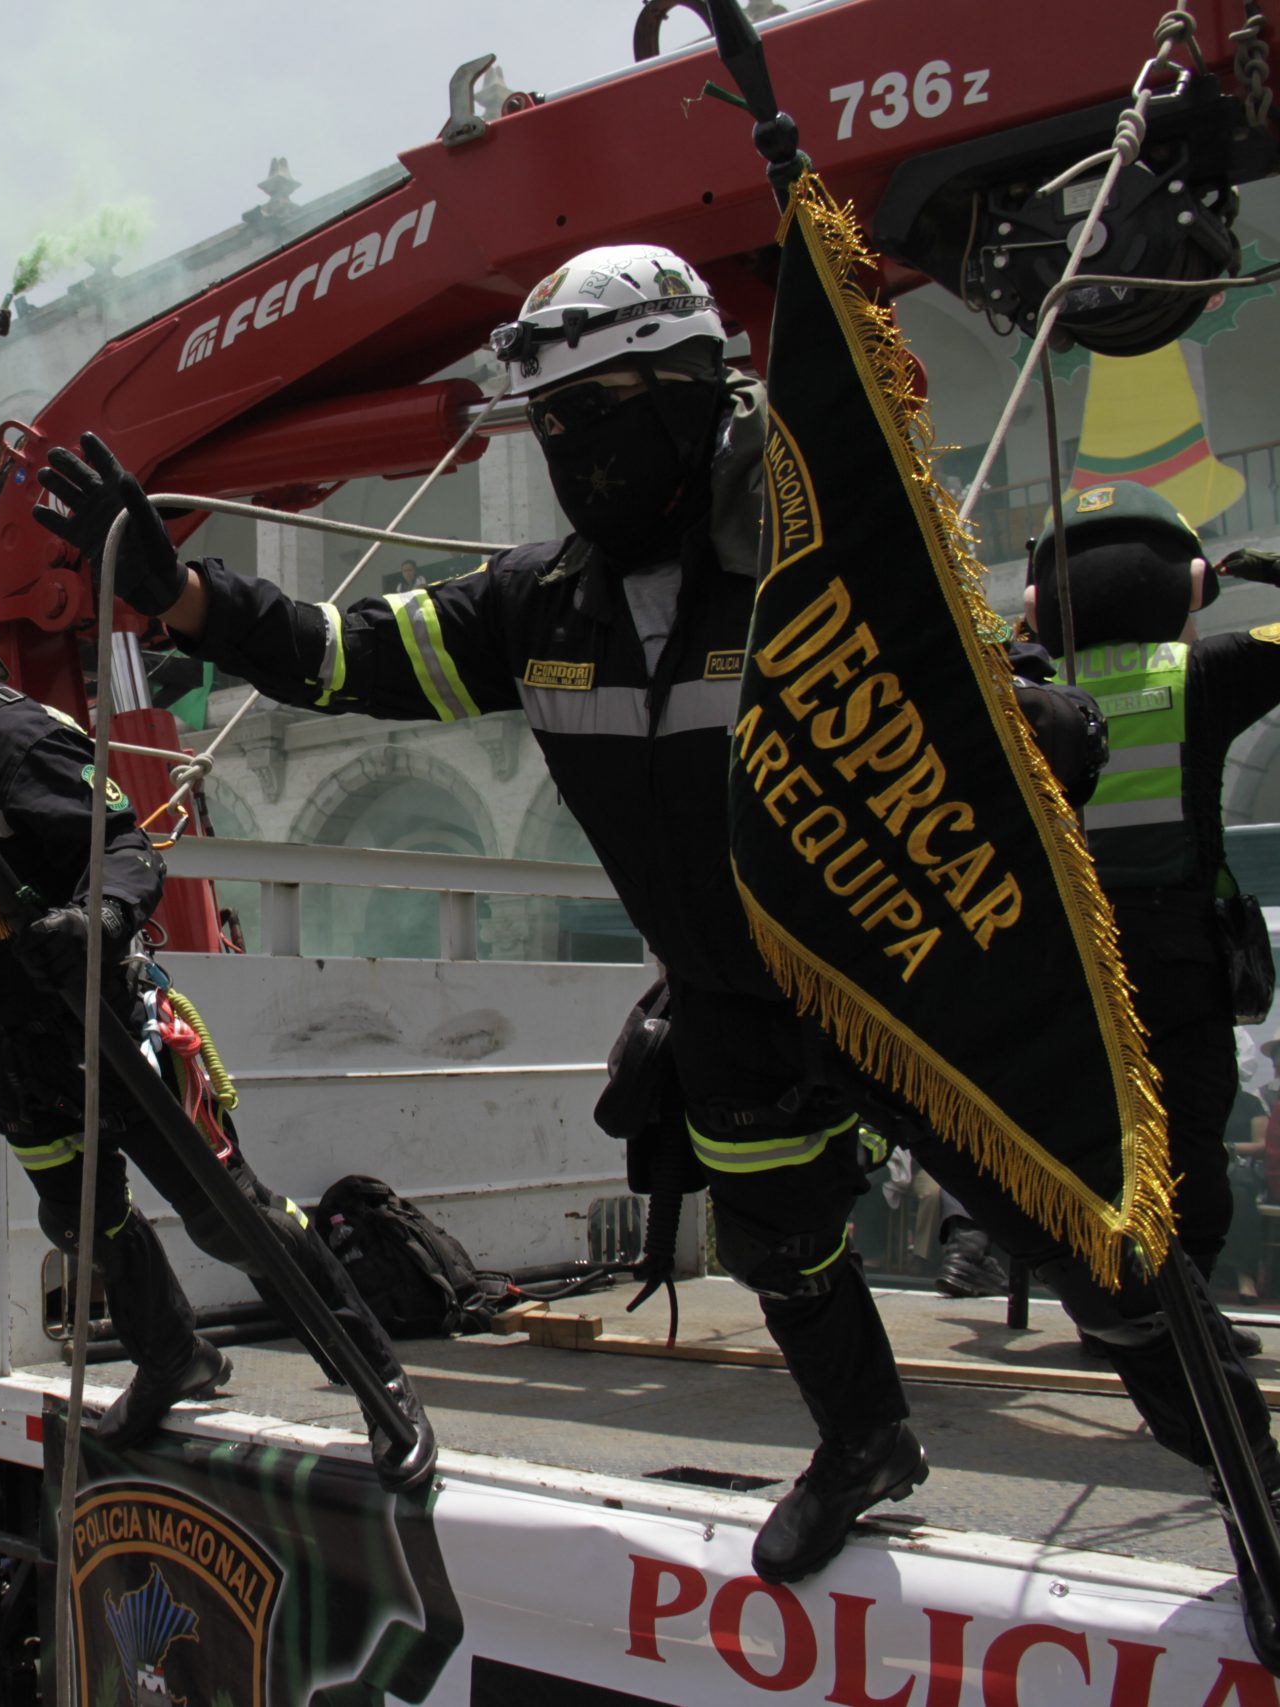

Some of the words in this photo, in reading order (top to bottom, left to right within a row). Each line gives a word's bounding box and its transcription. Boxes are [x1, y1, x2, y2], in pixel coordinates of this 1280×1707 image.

[829, 60, 953, 141] 736
[766, 431, 810, 549] NACIONAL
[710, 656, 741, 672] POLICIA
[1058, 642, 1177, 681] OLICIA
[756, 577, 1022, 951] DESPRCAR
[734, 704, 942, 983] AREQUIPA
[74, 1506, 144, 1558] POLICIA
[148, 1509, 259, 1612] NACIONAL
